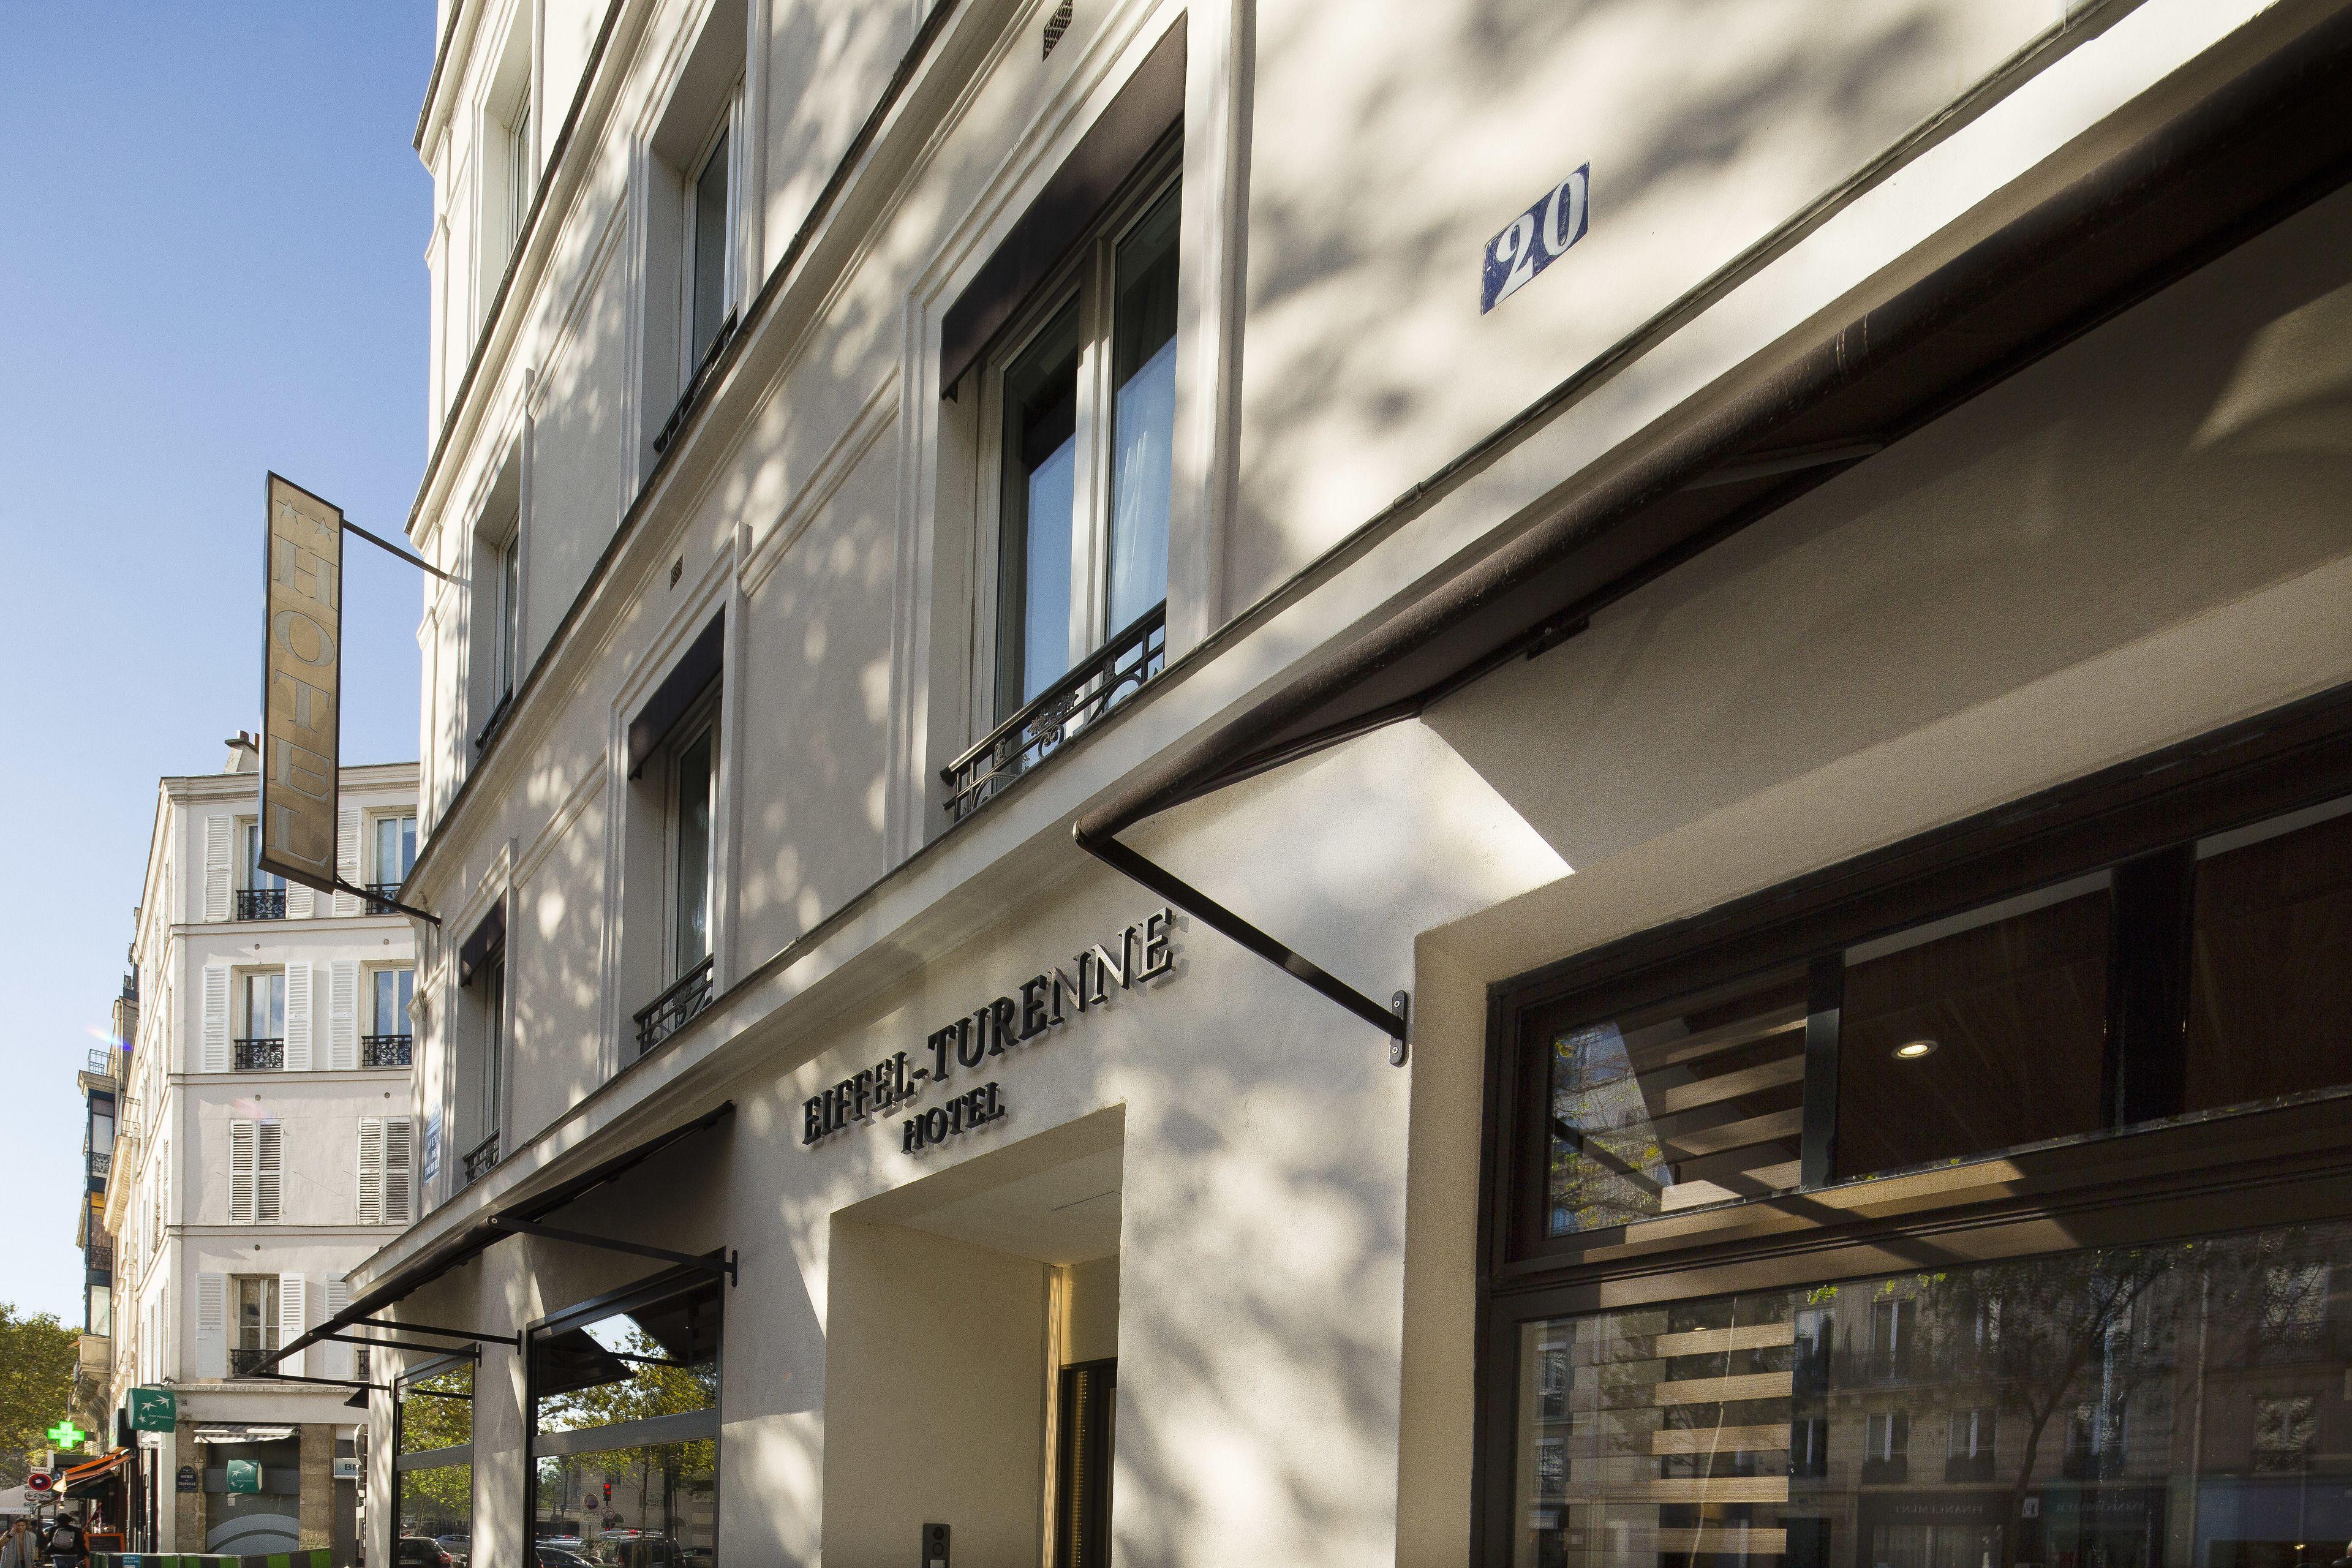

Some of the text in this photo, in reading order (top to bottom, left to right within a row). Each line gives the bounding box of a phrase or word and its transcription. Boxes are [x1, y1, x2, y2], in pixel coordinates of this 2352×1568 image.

[1494, 172, 1586, 307] 20
[268, 532, 338, 867] HOTEL
[801, 907, 1174, 1145] EIFFEL-TURENNE
[900, 1082, 1006, 1154] HOTEL
